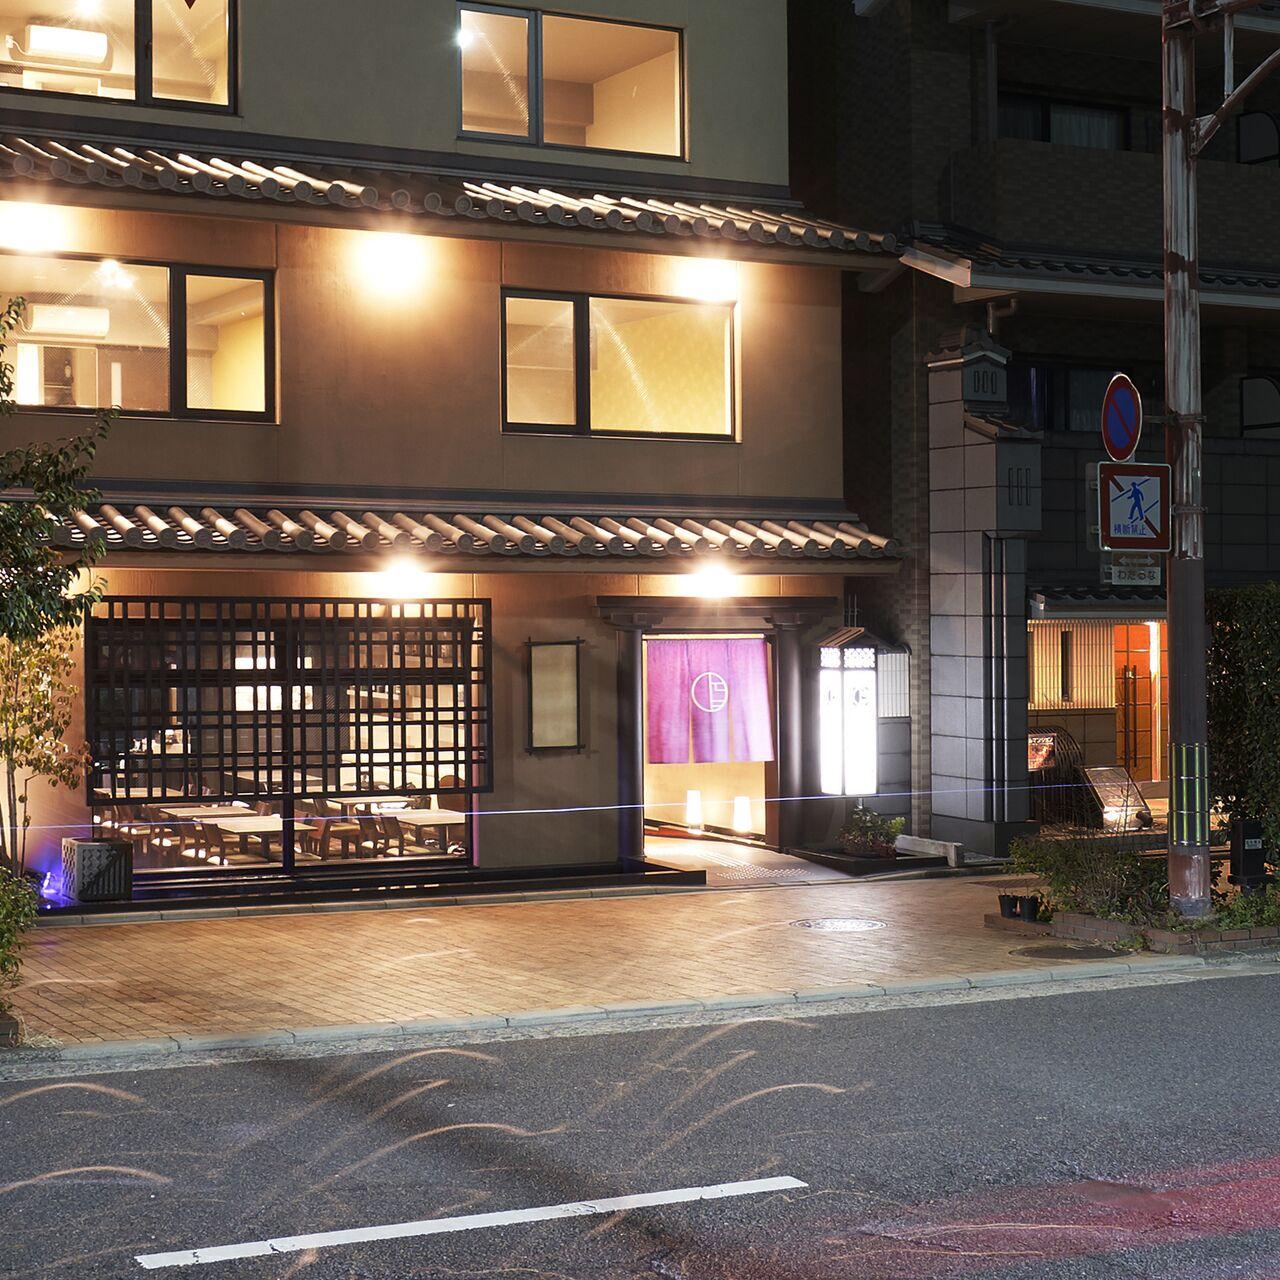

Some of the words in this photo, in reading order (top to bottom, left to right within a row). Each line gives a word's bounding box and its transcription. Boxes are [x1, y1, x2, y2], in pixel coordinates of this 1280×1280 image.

[1114, 523, 1147, 536] 横断禁止
[1117, 570, 1157, 581] わたるな
